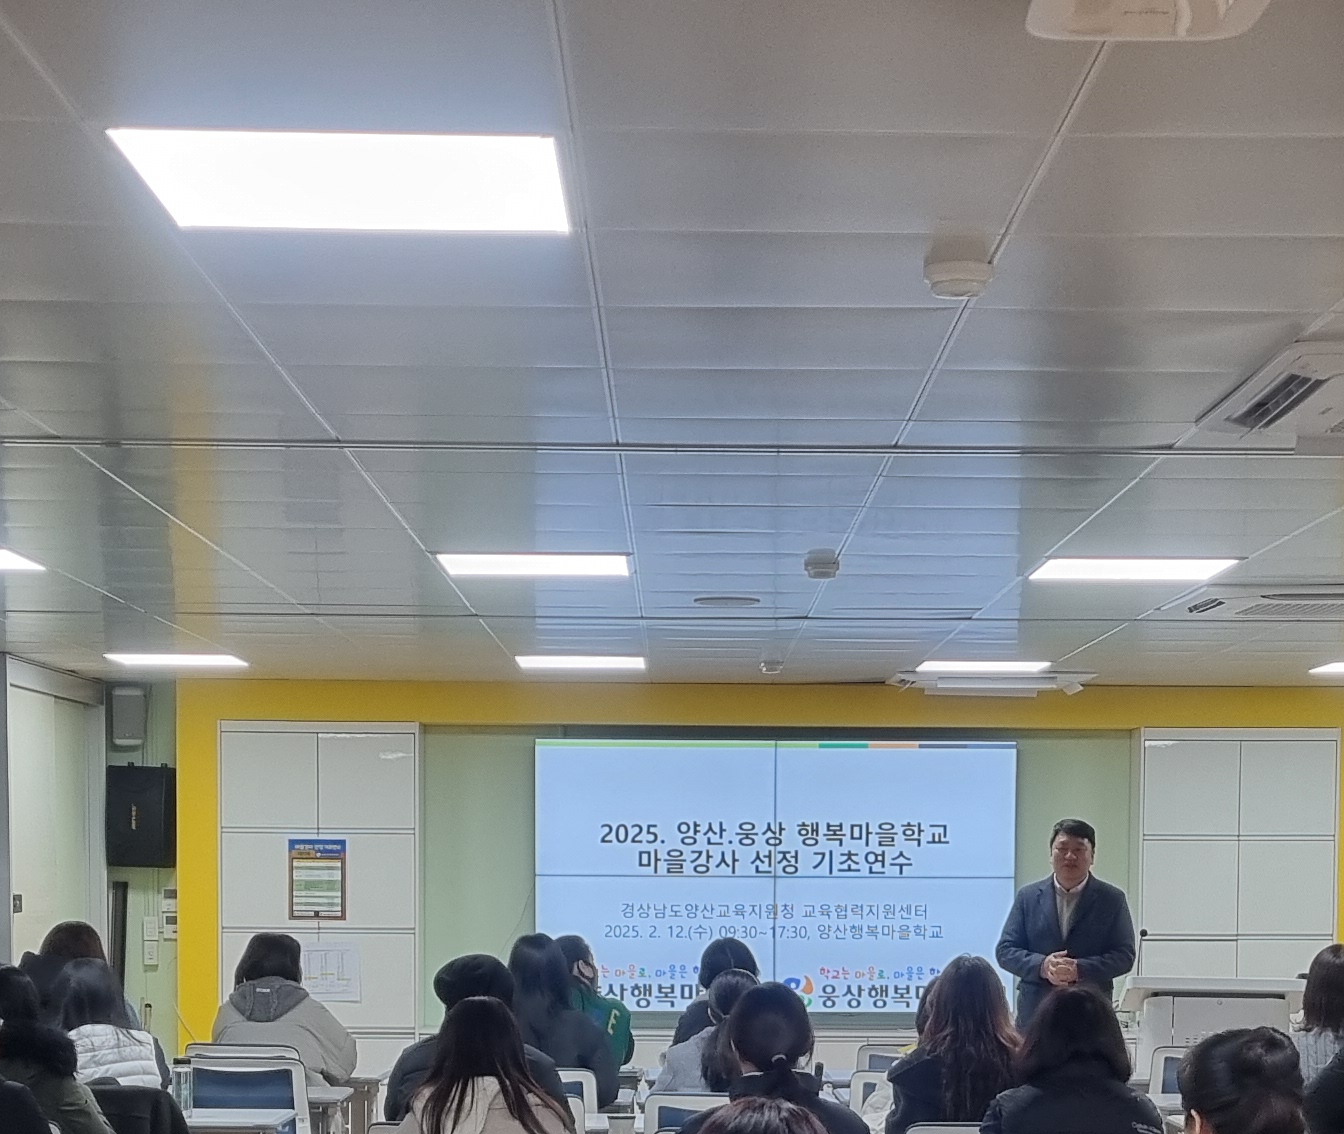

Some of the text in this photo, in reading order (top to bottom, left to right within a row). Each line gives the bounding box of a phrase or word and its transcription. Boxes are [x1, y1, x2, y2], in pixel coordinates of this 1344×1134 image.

[600, 820, 951, 848] 2025. 양산.웅상 행복마을학교
[637, 848, 914, 876] 마을강사 선정 기초연수
[620, 902, 928, 921] 경상남도양산교육지원청 교육협력지원센터
[604, 923, 644, 940] 2025.
[648, 923, 663, 940] 2.
[817, 923, 944, 942] 양산행복마을학교
[819, 965, 851, 981] 학교는
[818, 984, 924, 1010] 웅상행복
